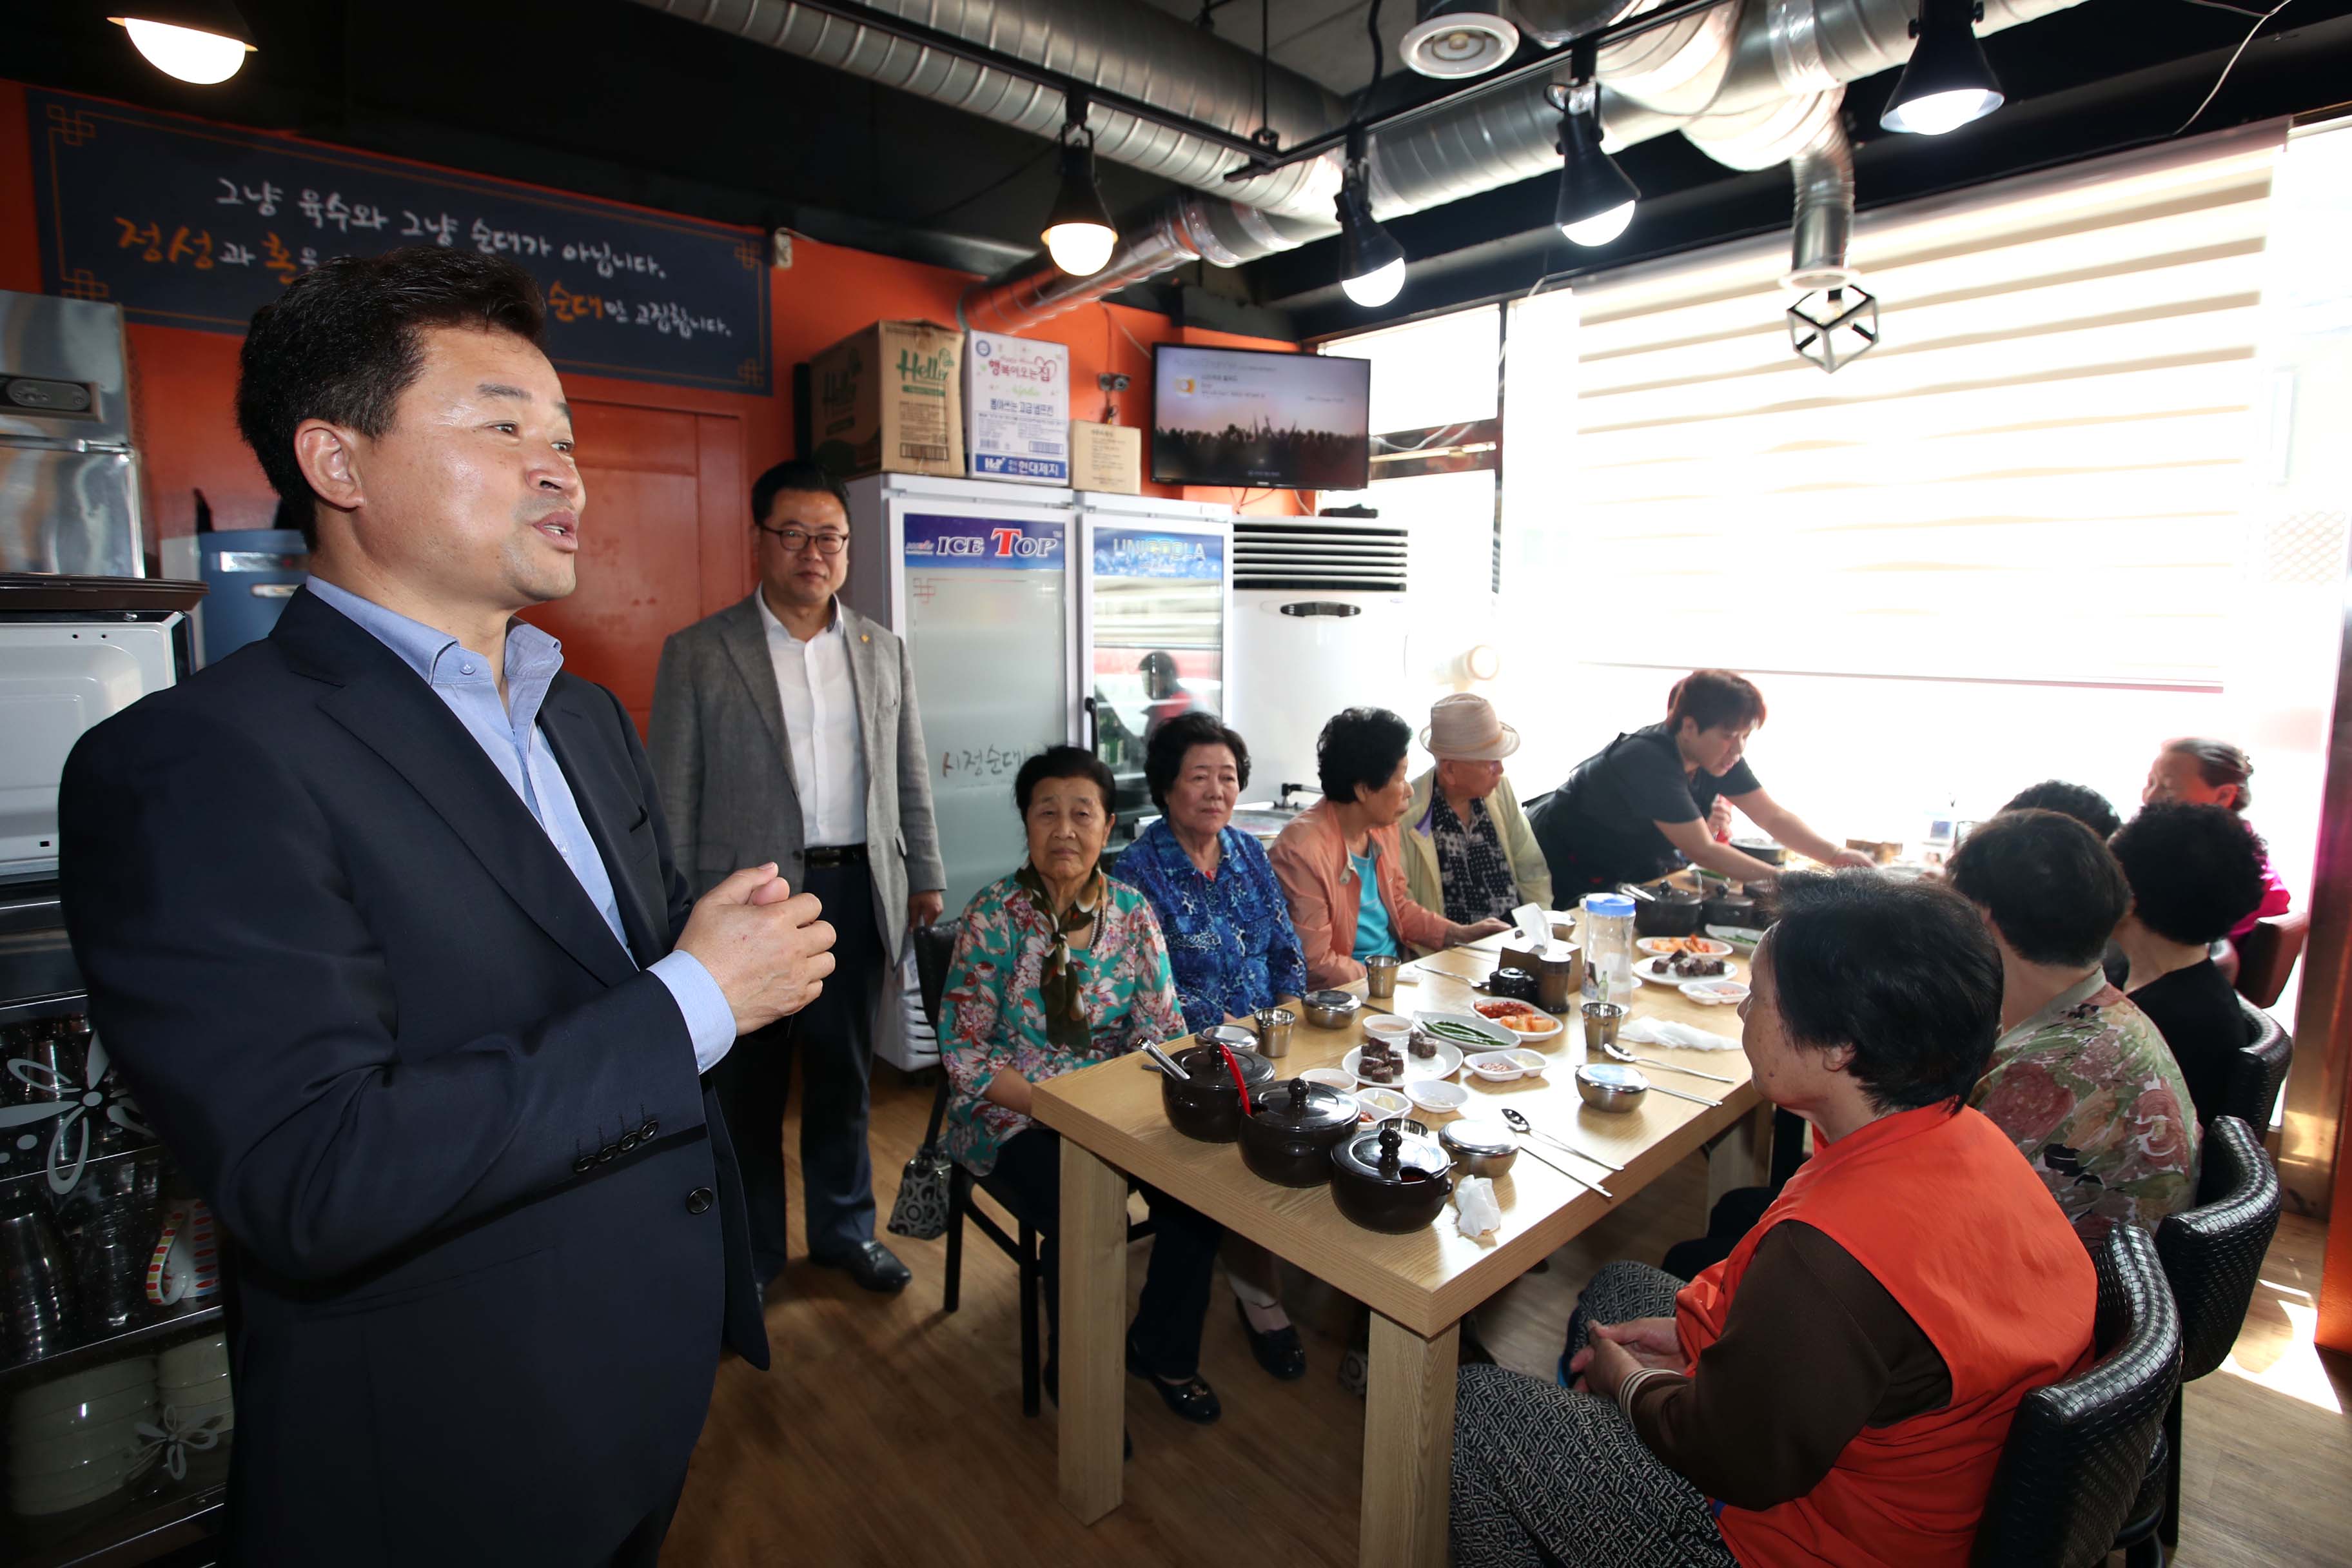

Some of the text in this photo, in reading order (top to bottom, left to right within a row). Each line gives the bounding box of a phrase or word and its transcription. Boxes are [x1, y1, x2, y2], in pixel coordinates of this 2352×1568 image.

[114, 216, 257, 268] 정성과
[549, 280, 629, 321] 순대만
[216, 177, 667, 279] 그냥 육수와 그냥 순대가 아닙니다.
[936, 536, 985, 556] ICE
[990, 527, 1058, 557] TOP
